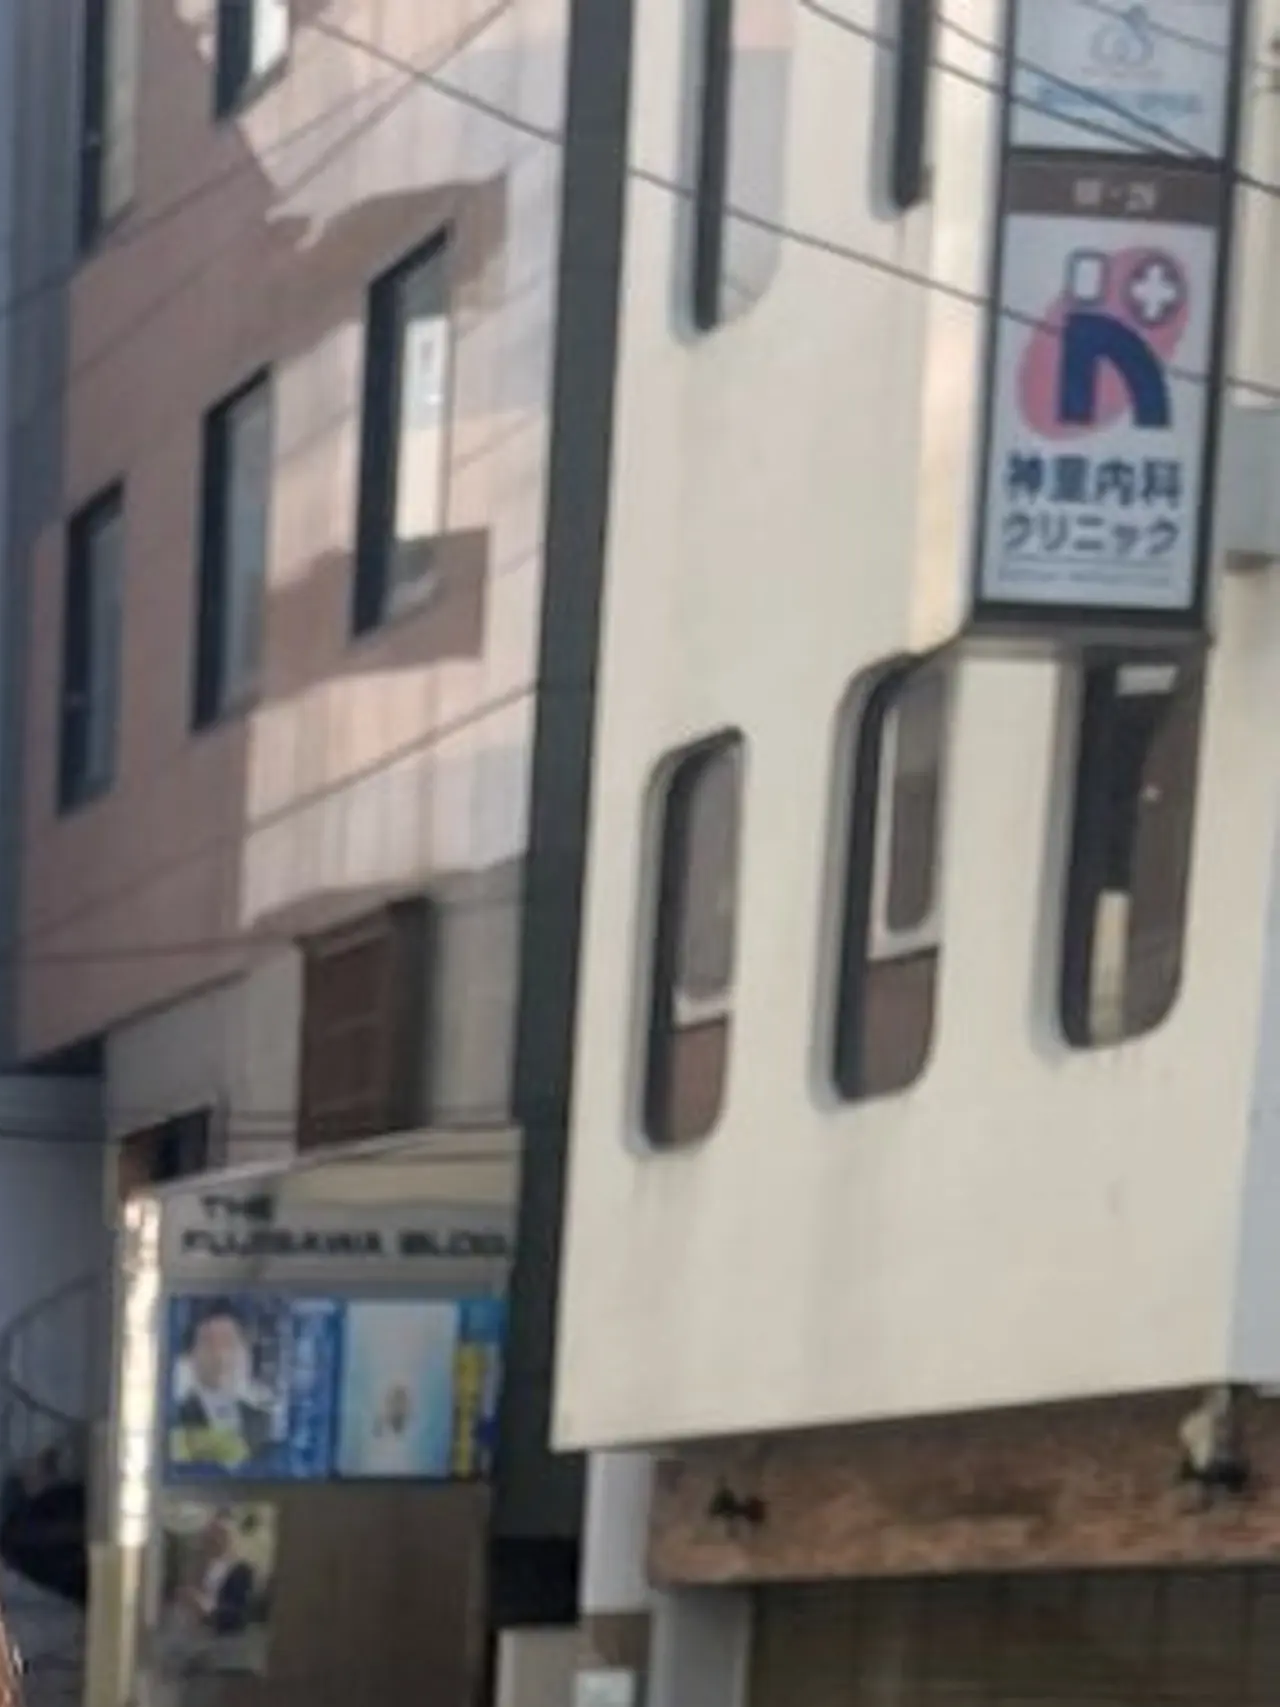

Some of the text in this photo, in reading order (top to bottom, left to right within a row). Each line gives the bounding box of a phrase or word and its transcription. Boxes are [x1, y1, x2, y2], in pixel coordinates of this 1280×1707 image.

[1004, 511, 1180, 555] クリニック
